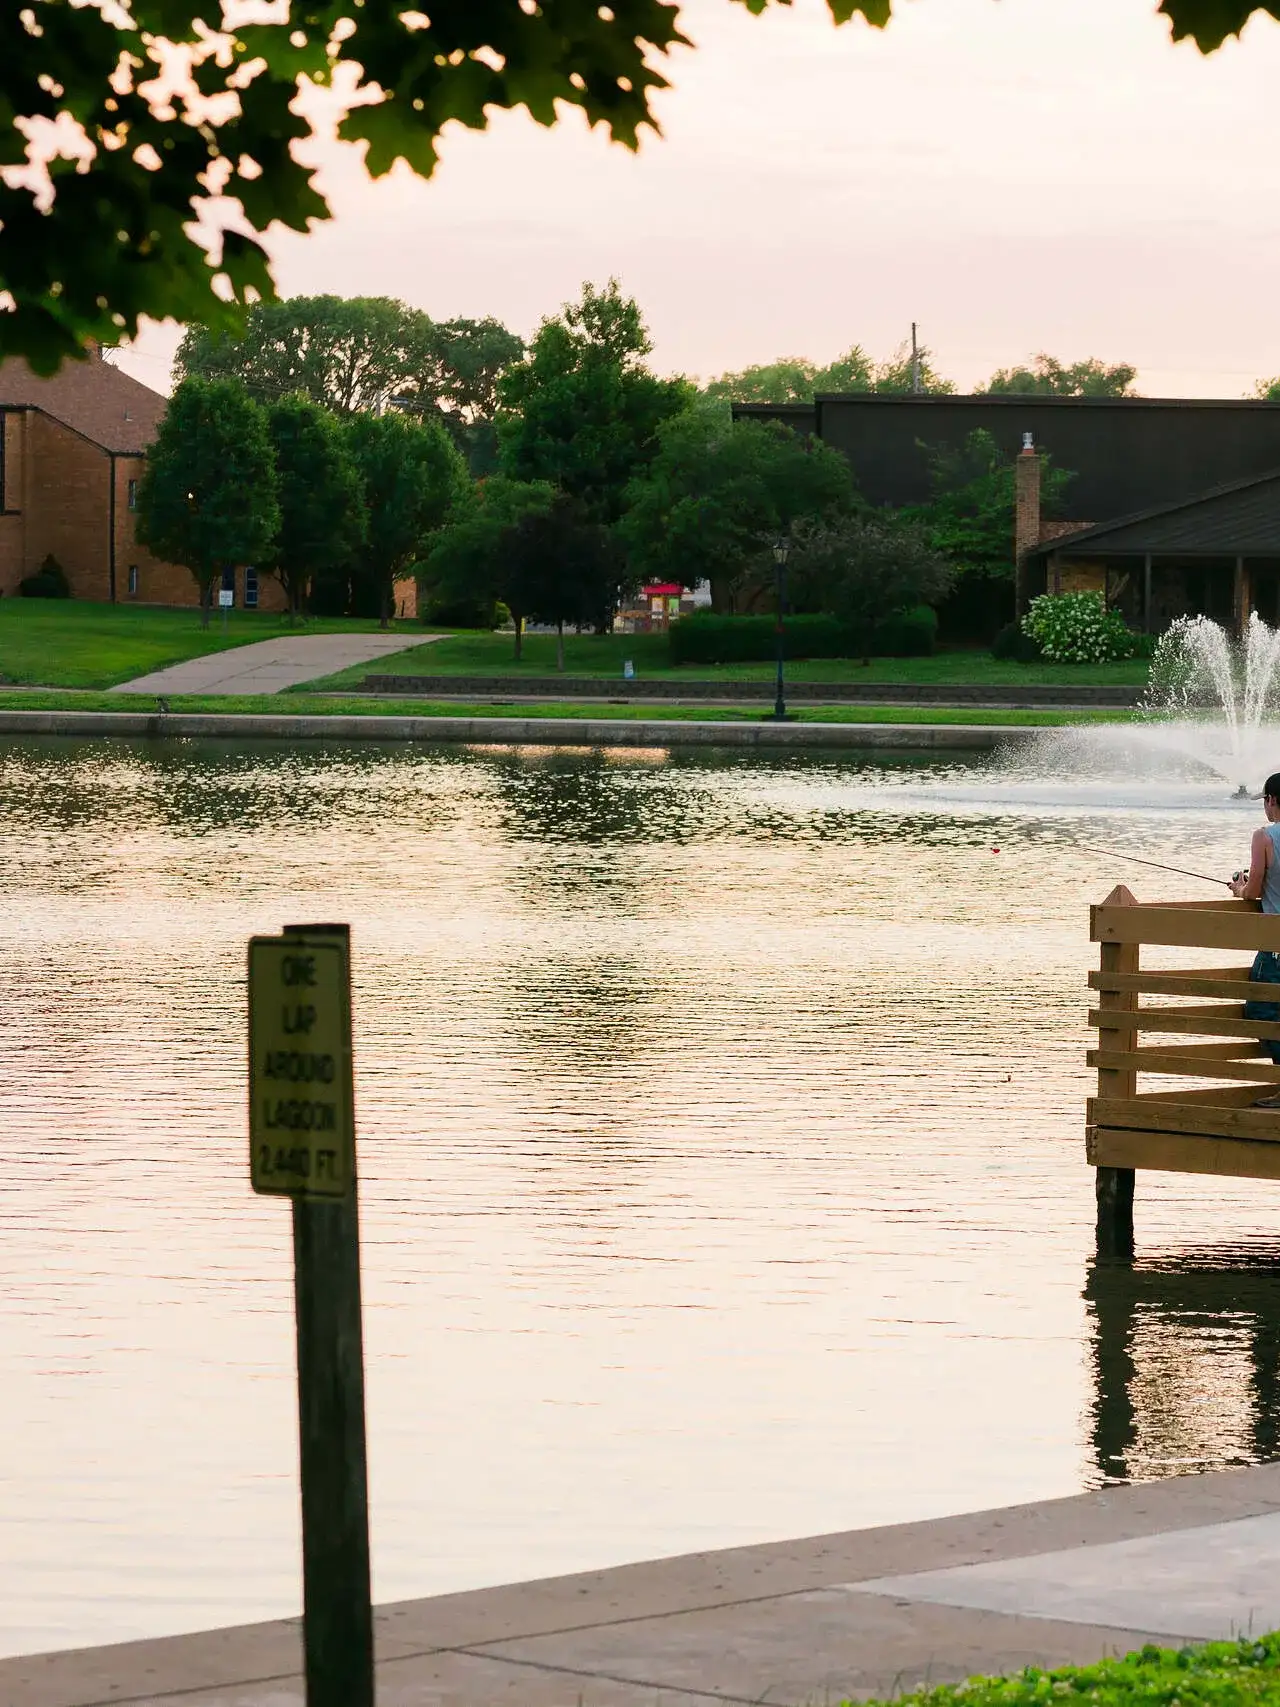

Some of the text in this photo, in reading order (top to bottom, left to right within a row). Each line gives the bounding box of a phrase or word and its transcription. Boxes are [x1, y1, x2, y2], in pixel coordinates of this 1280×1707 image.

[281, 956, 319, 987] ONE
[282, 1004, 318, 1035] LAP
[263, 1051, 336, 1084] AROUND
[263, 1099, 337, 1132] LAGOON
[316, 1149, 337, 1180] FT
